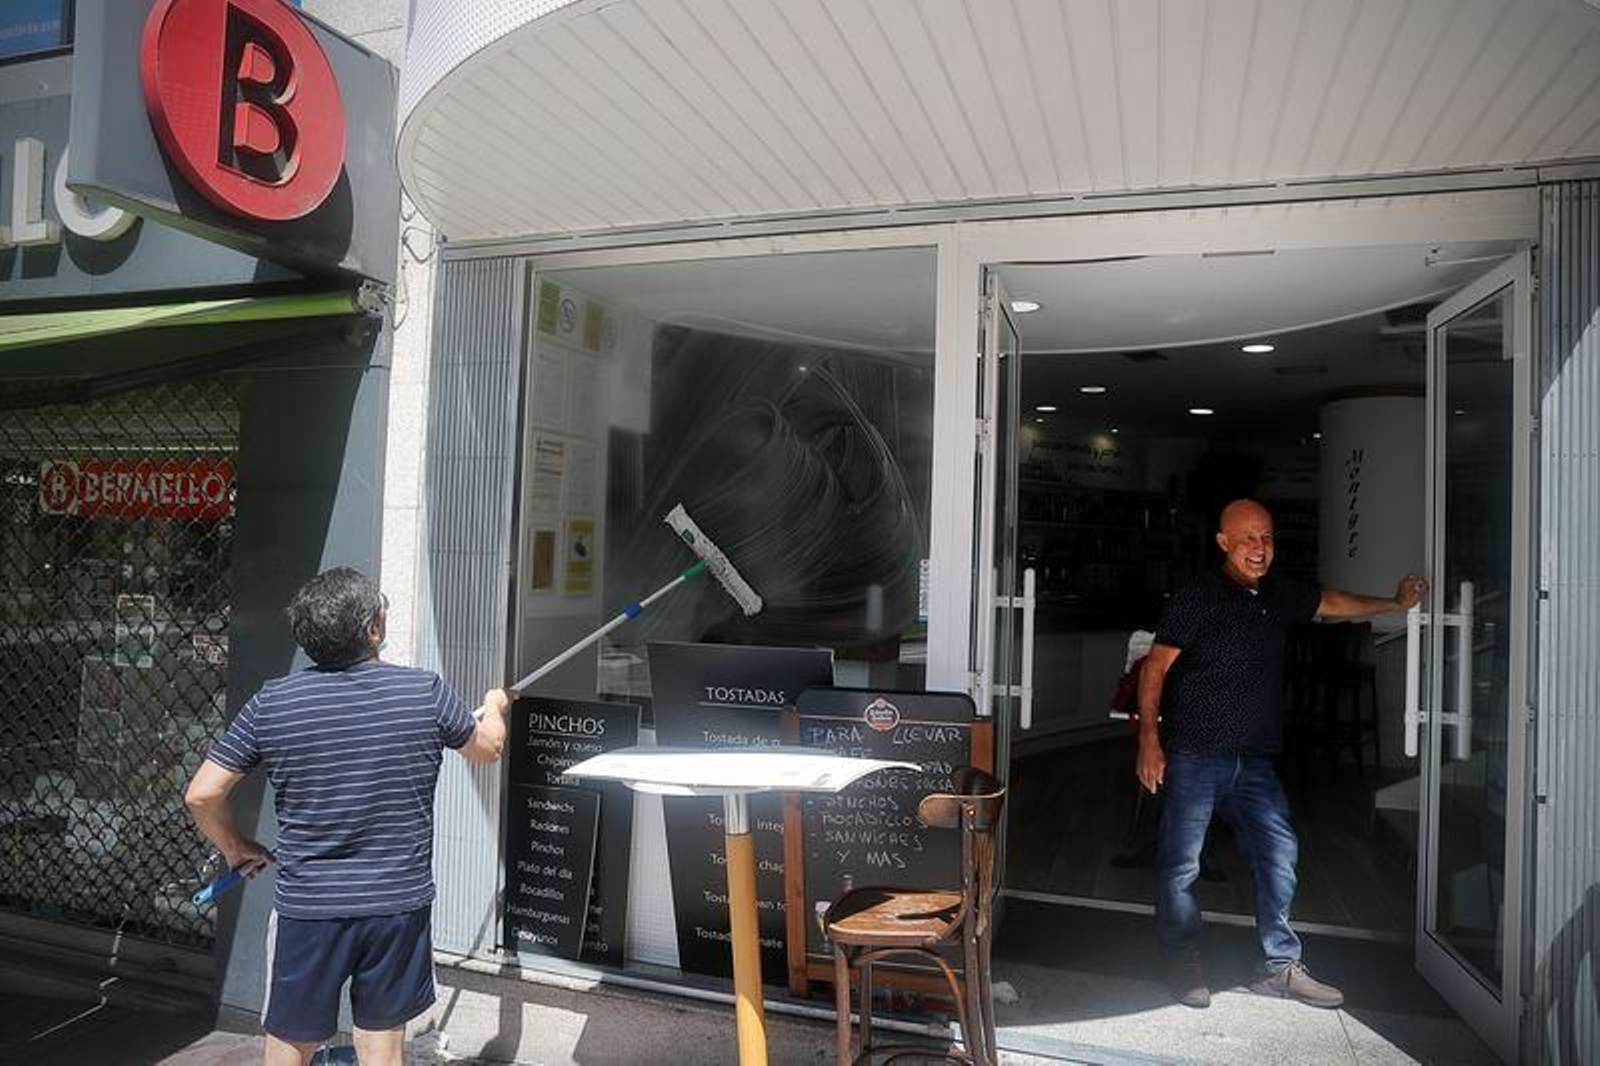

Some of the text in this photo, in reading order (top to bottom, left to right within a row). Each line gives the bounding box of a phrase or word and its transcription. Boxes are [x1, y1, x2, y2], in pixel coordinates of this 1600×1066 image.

[215, 1, 302, 188] B
[83, 471, 226, 504] BERMELLO
[705, 686, 785, 704] TOSTADAS
[528, 713, 605, 735] PINCHOS
[703, 731, 748, 745] Tostada
[808, 726, 963, 745] PARA LLEVAR
[531, 841, 564, 855] Pinchos
